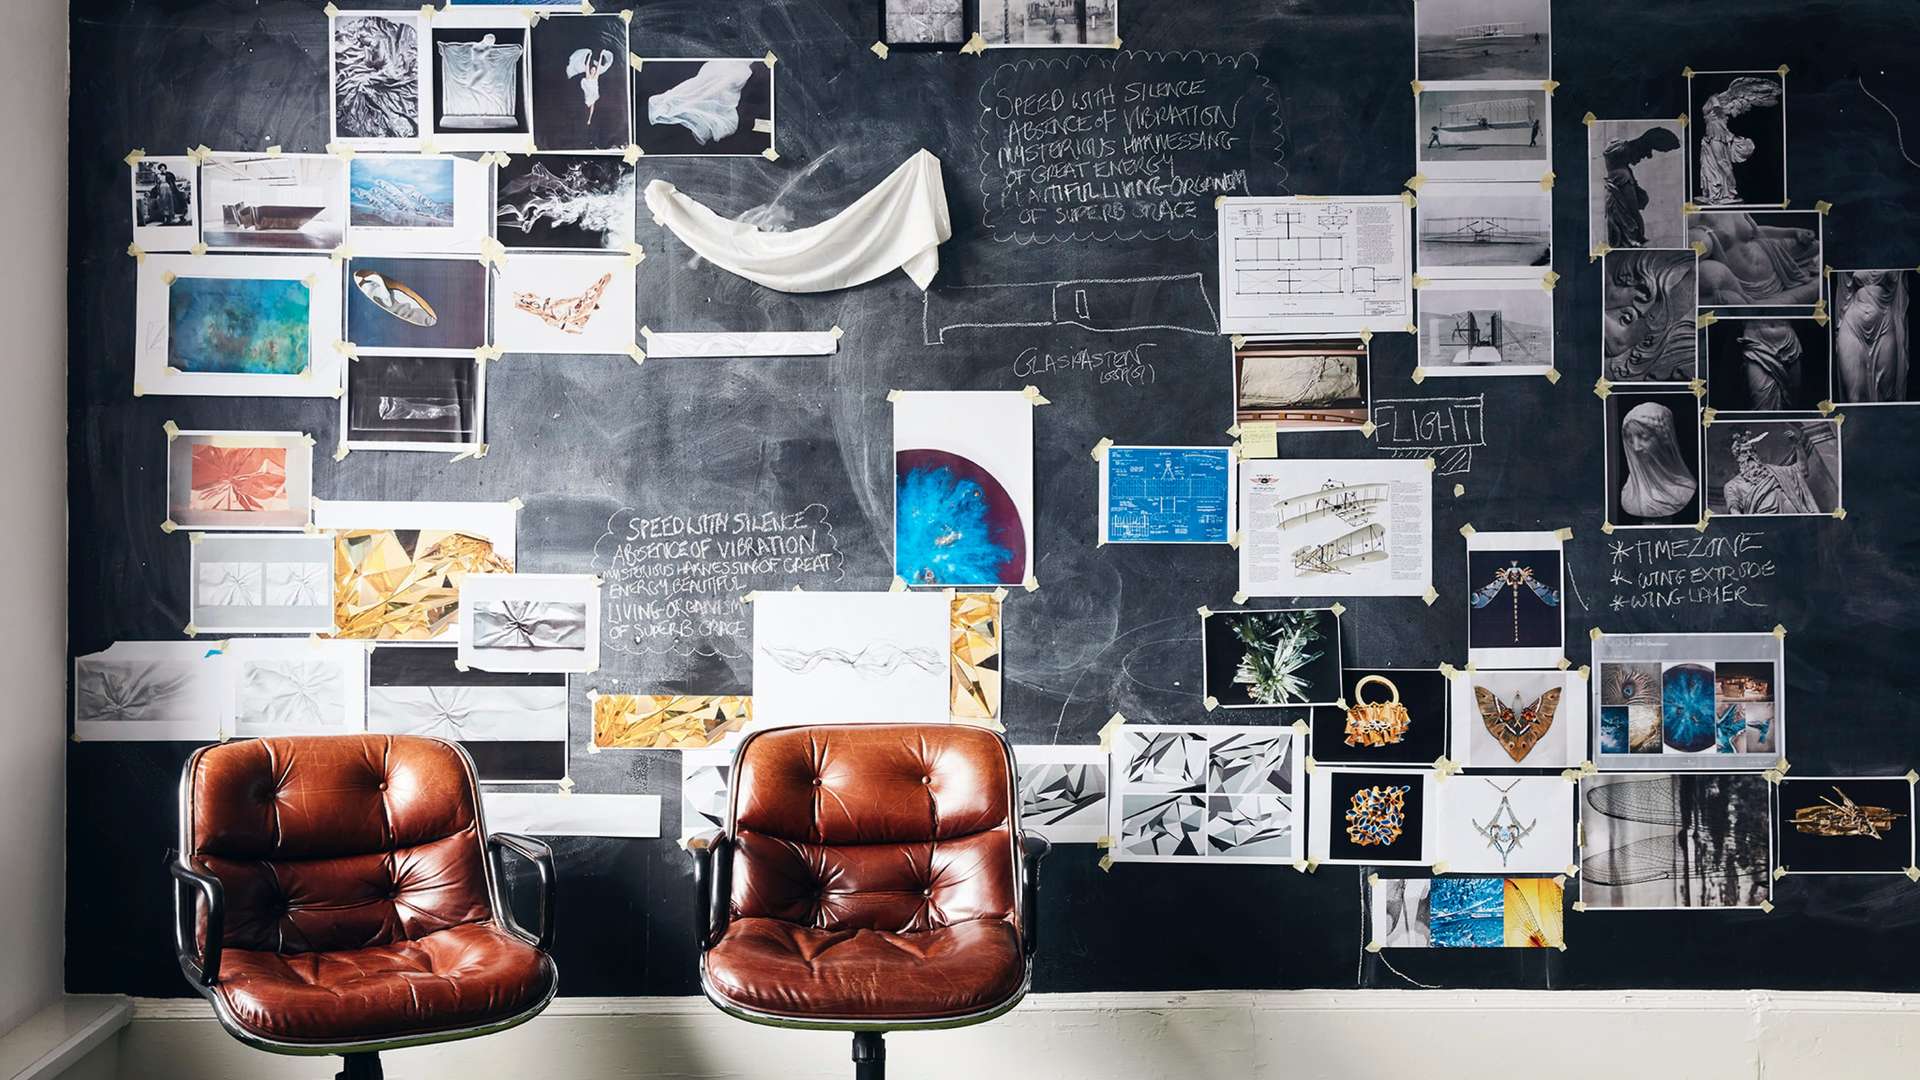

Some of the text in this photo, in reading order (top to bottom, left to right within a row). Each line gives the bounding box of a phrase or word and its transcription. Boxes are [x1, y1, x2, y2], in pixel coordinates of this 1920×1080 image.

[995, 79, 1206, 119] SPEED WITH SILENCE
[1008, 115, 1093, 146] ABSENCE
[1122, 95, 1244, 135] VIBRATION
[998, 131, 1240, 169] MYSTERIOUS HARNESSING
[1006, 154, 1174, 187] OF GREAT ENERGY
[1103, 176, 1164, 199] LIVING
[1019, 207, 1046, 225] OF
[1375, 404, 1481, 442] FLIGHT
[626, 511, 808, 541] SPEED WITH SILENCE
[610, 529, 816, 570] ABSENCE OF VIBRATION
[1635, 531, 1765, 565] TIMEZONE
[602, 563, 674, 582] MYSTERIOUS
[677, 560, 758, 577] HARNESSING
[783, 553, 833, 574] GREAT
[1638, 569, 1686, 589] WING
[609, 575, 747, 600] ENERGY BEAUTIFUL
[1631, 583, 1769, 609] WING LAYER
[607, 598, 746, 624] LIVING ORGANISM
[609, 619, 748, 640] OF SUPERB GRACE
